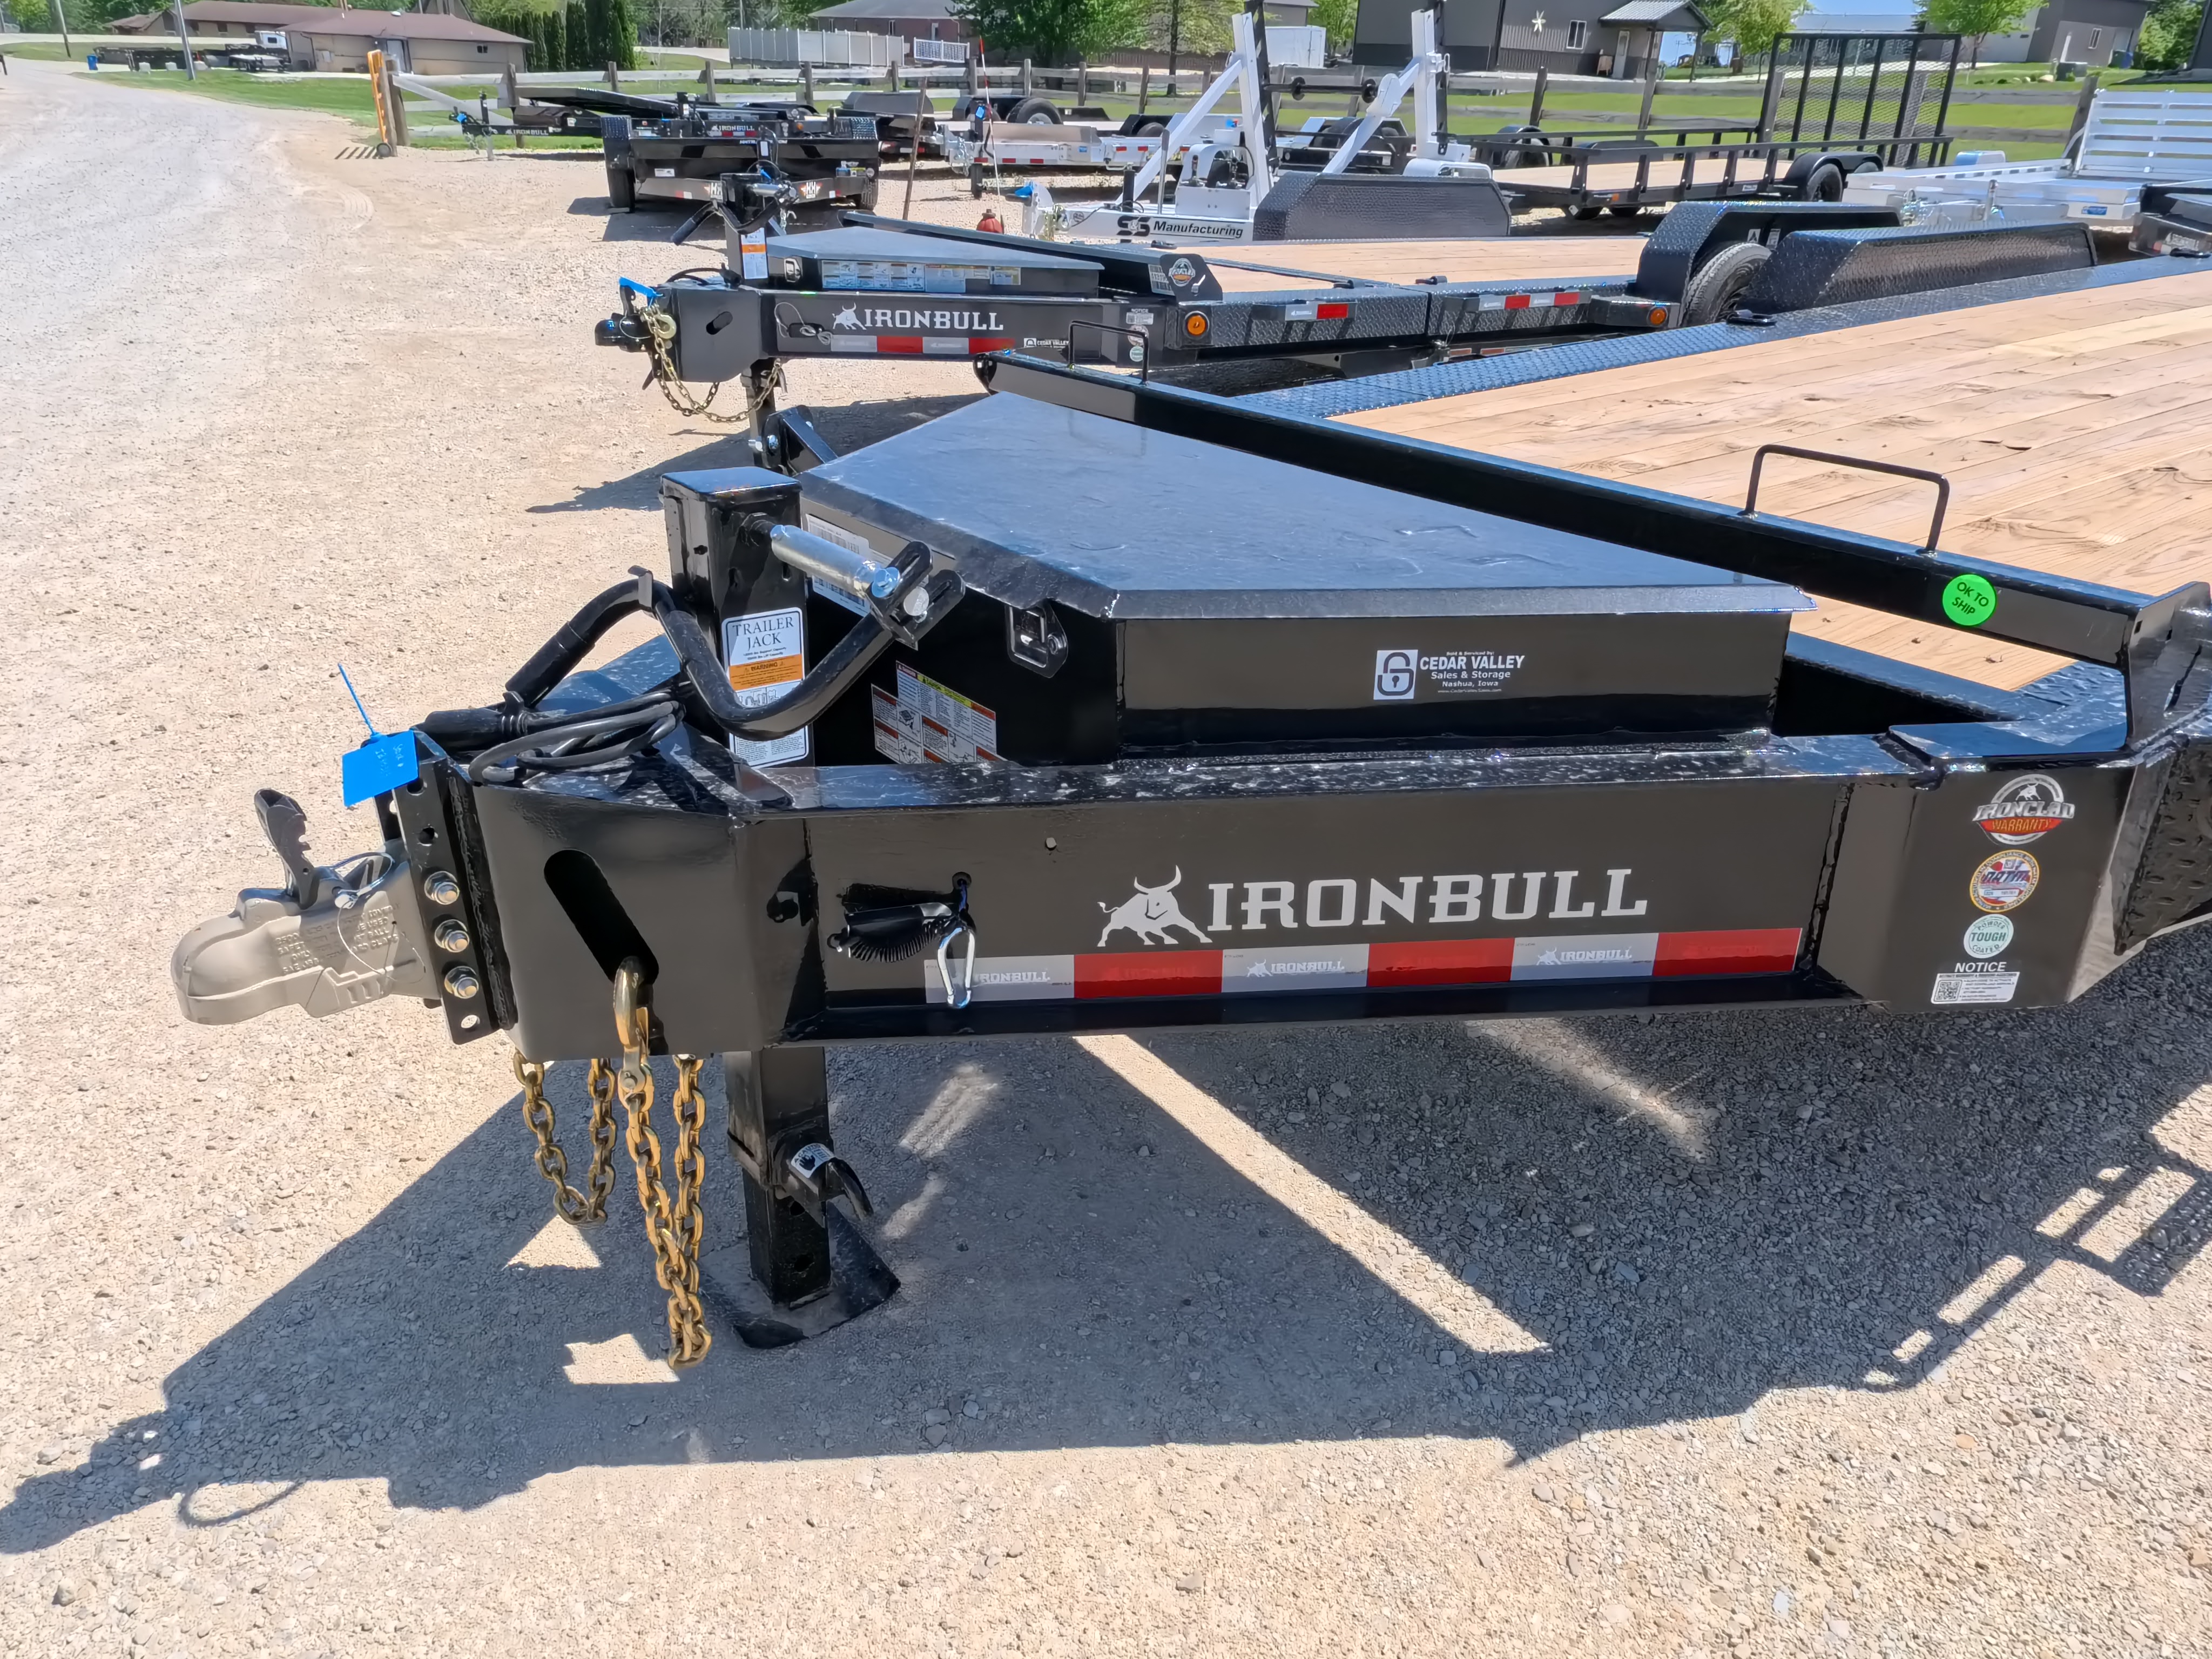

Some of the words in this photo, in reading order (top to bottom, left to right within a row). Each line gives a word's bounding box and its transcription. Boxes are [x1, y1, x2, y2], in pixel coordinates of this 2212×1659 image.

[1154, 221, 1243, 239] Manufacturing
[864, 309, 1003, 330] IRONBULL
[1957, 582, 1974, 597] OK
[1974, 592, 1989, 606] TO
[1952, 597, 1975, 615] SHIP
[732, 616, 794, 636] TRAILER
[747, 632, 781, 651] JACK
[751, 662, 778, 671] WARNING
[1420, 656, 1467, 670] CEDAR
[1471, 655, 1525, 669] VALLEY
[1471, 671, 1510, 679] Storage
[1972, 801, 2075, 821] IRONCLAD
[1992, 819, 2052, 831] WARRANTY
[1206, 868, 1648, 932] IRONBULL
[1978, 921, 2005, 930] POWDER
[1971, 932, 2006, 942] TOUGH
[1560, 948, 1632, 962] IRONBULL
[1973, 944, 2000, 953] COATED
[1271, 961, 1345, 973] IRONBULL
[1954, 962, 2007, 973] NOTICE
